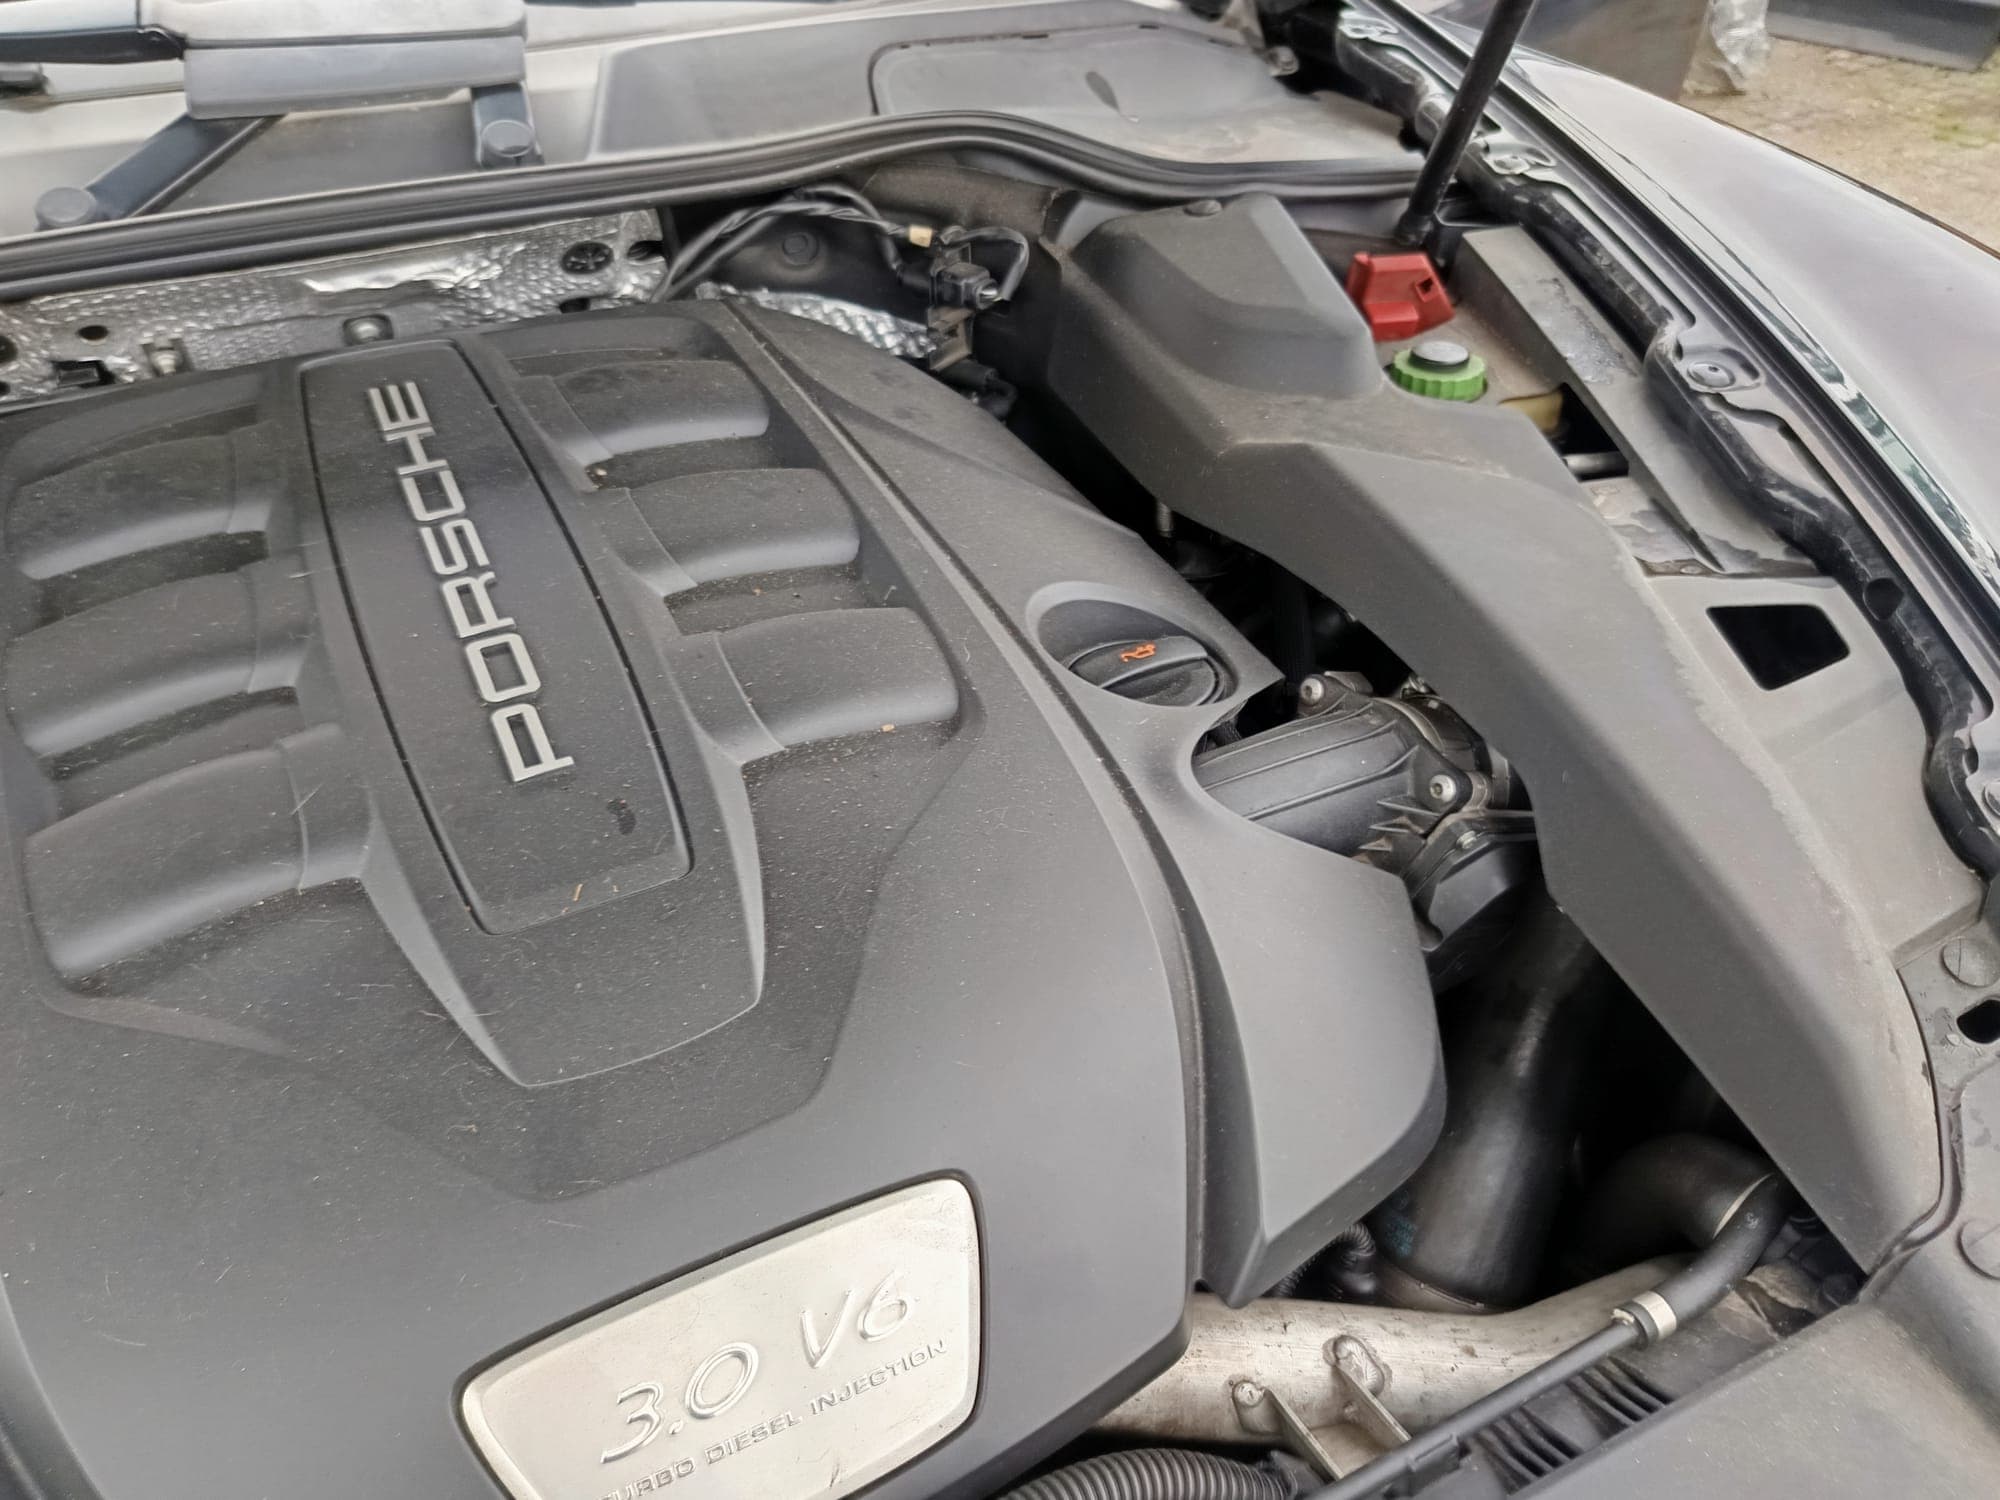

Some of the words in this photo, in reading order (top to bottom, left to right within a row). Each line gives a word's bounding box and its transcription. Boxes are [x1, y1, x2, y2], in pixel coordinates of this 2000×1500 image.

[368, 381, 574, 782] PORSCHE
[599, 1341, 760, 1464] 3.0
[800, 1269, 914, 1369] V6
[704, 1410, 803, 1465] DIESEL
[810, 1338, 948, 1415] INJECTION
